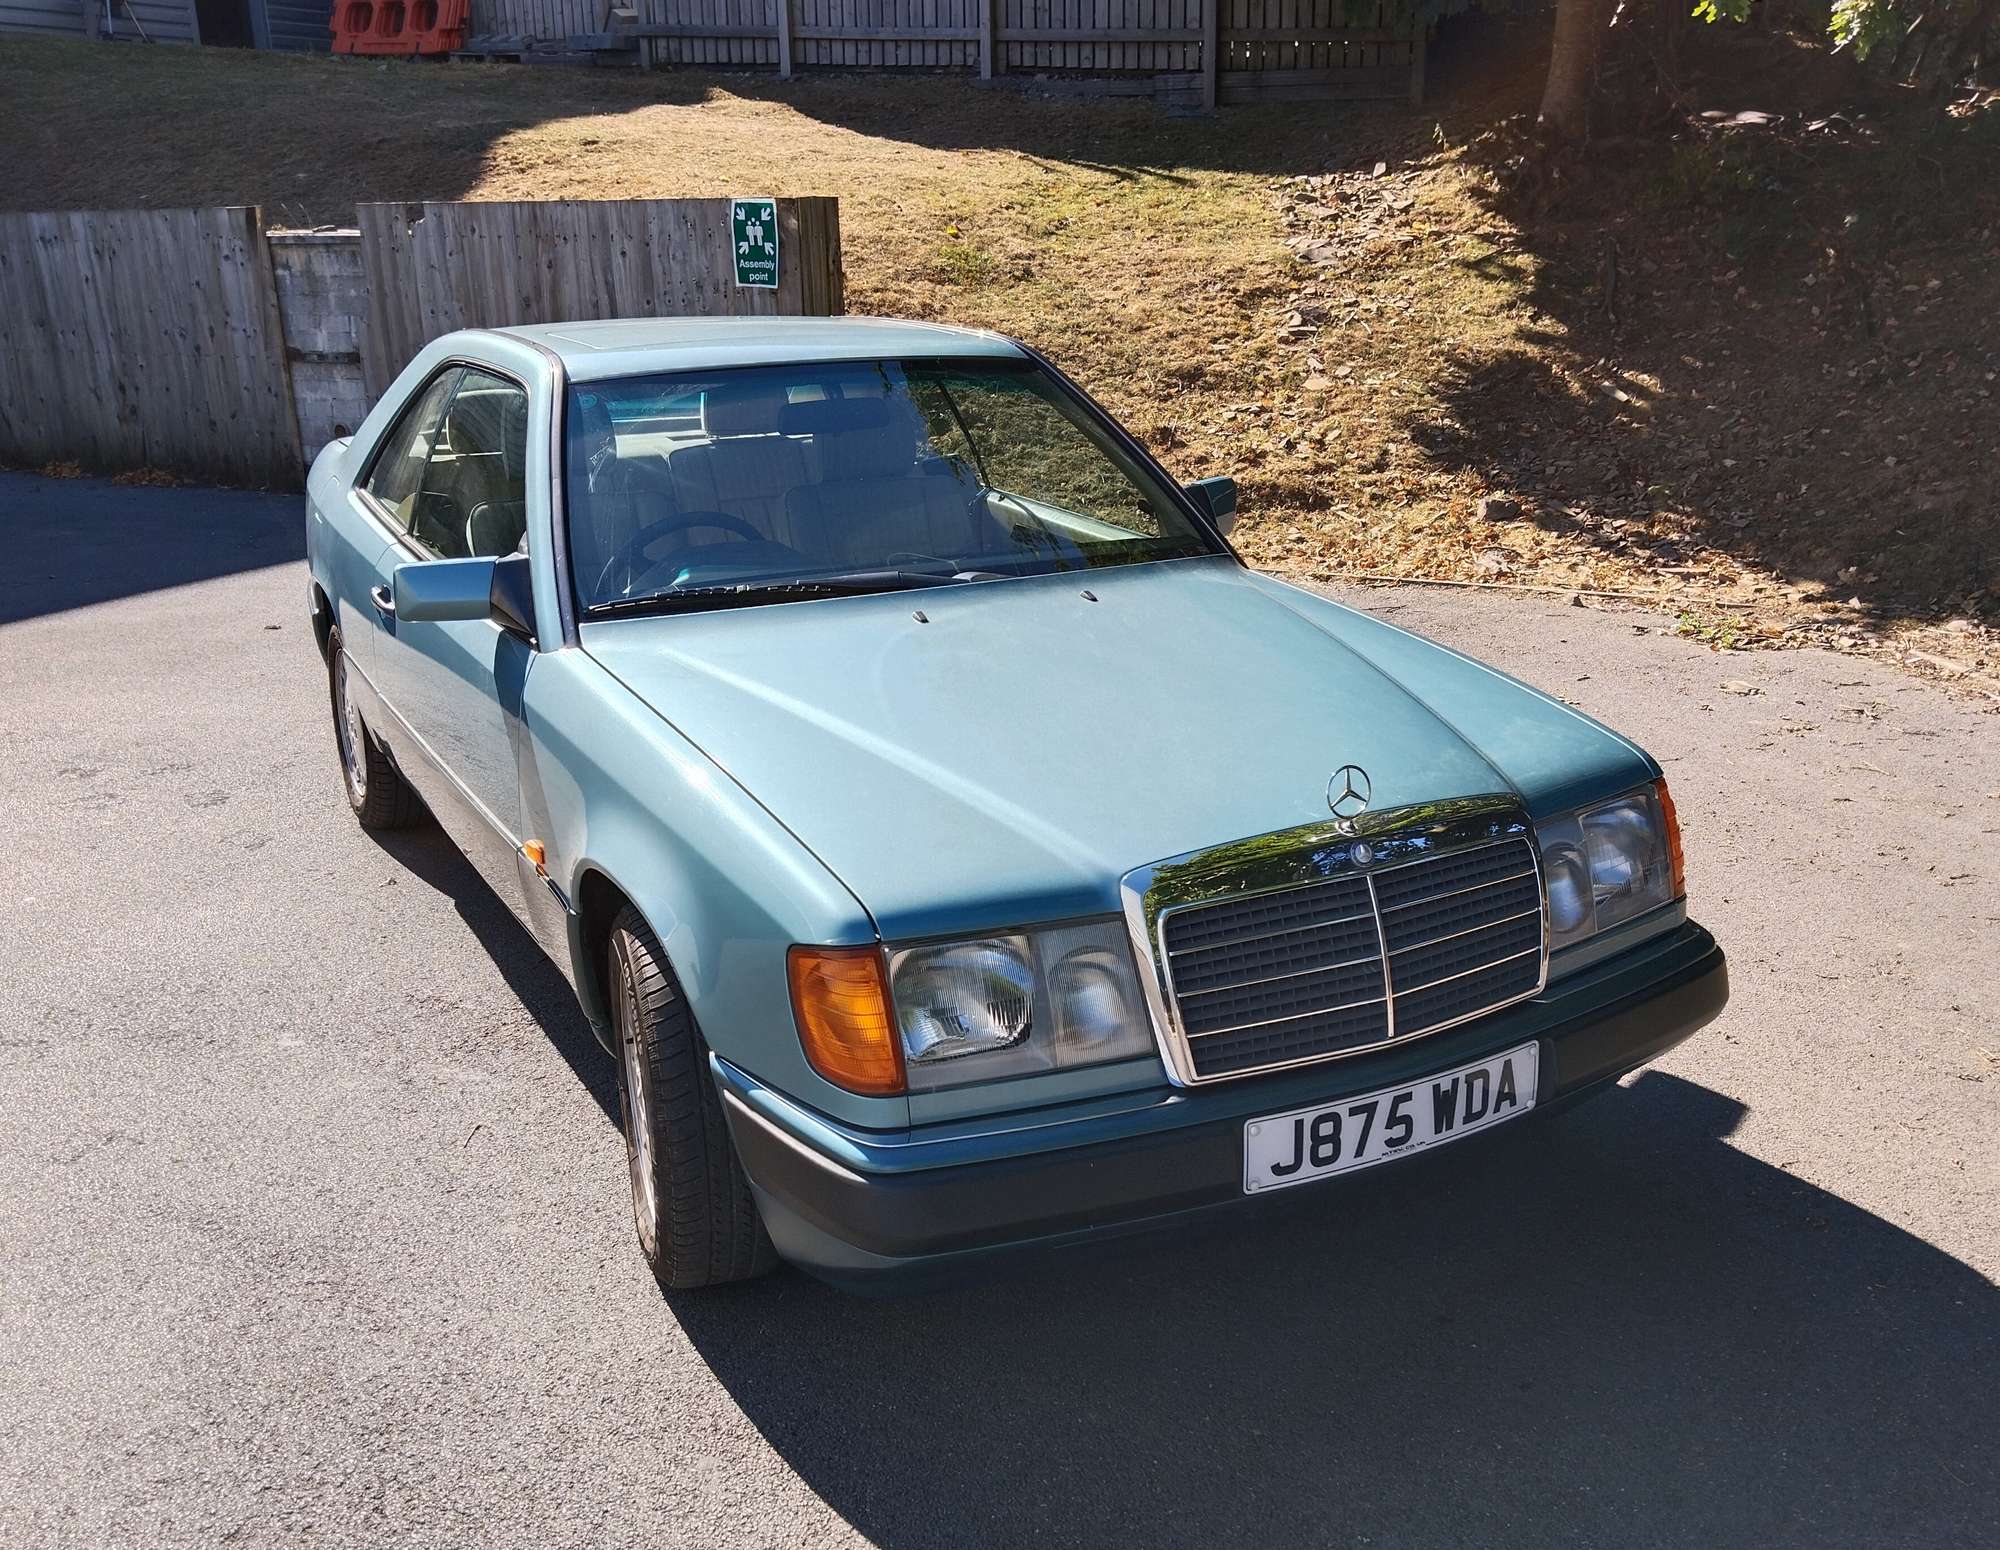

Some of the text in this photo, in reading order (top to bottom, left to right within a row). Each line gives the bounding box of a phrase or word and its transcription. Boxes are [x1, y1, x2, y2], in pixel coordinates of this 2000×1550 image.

[739, 259, 775, 271] Assembly
[749, 271, 769, 283] point
[1270, 1058, 1517, 1177] J875 WDA
